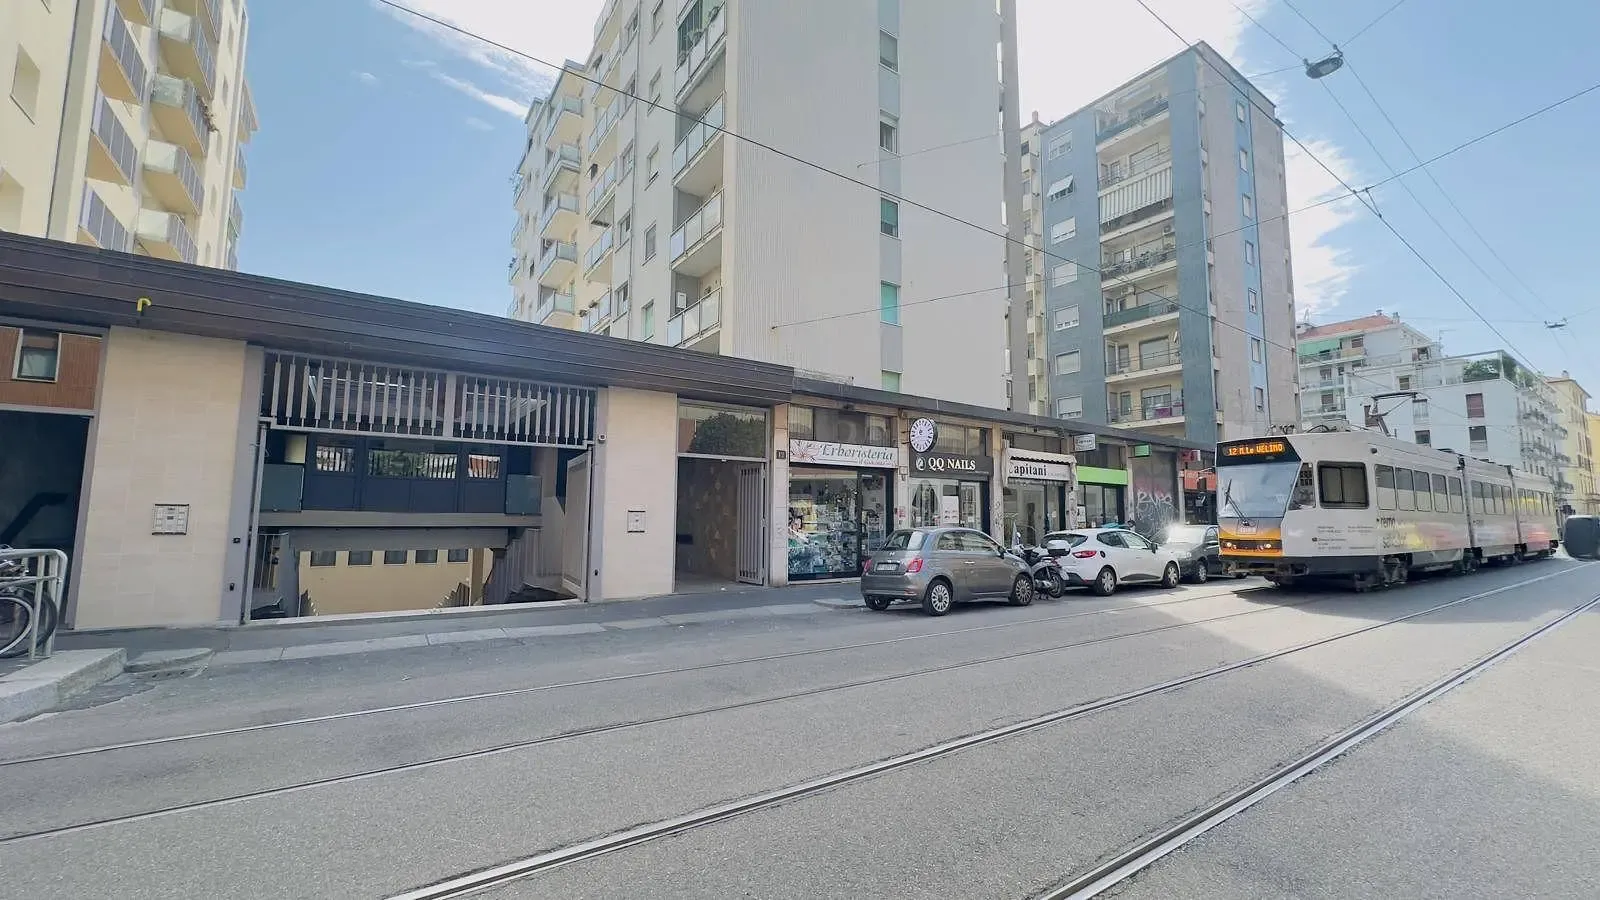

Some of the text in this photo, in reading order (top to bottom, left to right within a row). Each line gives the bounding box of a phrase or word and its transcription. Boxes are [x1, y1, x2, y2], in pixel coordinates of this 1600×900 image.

[820, 443, 894, 461] Erboristeria
[1228, 447, 1238, 456] 12
[928, 457, 976, 472] QQ NAILS
